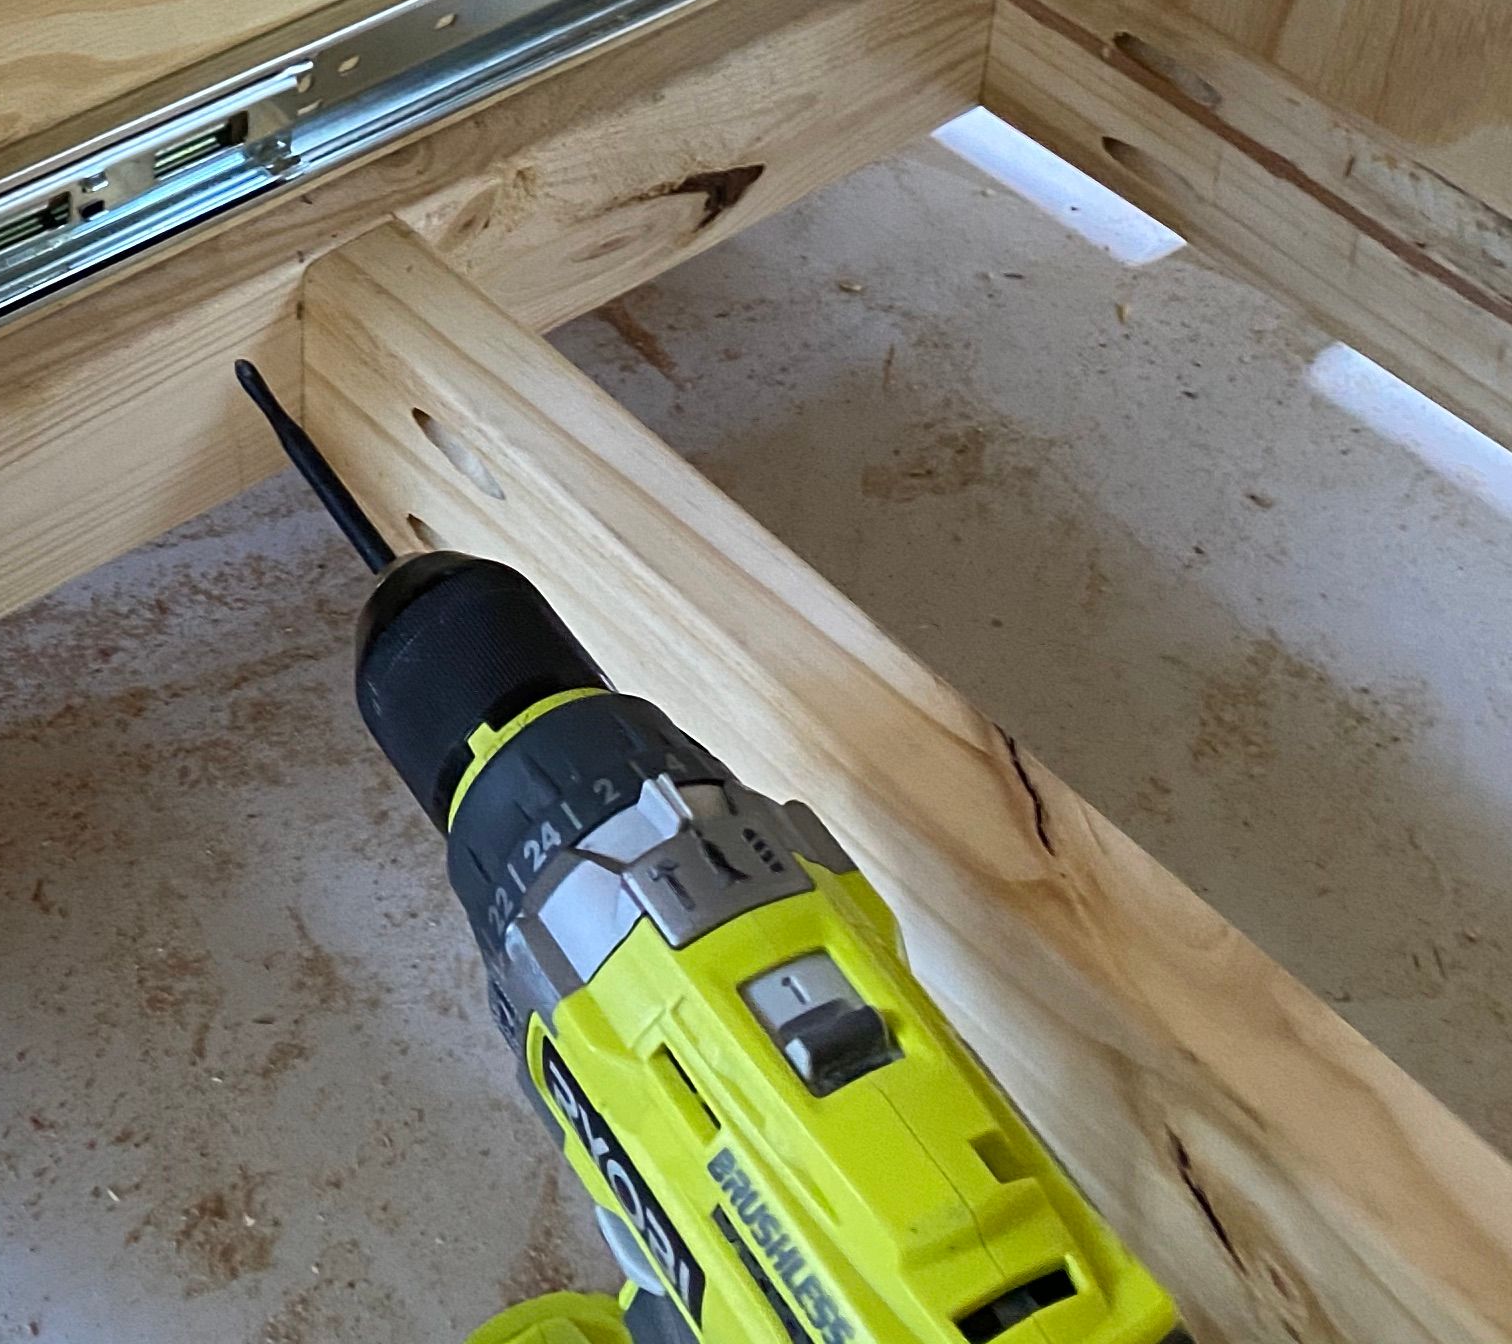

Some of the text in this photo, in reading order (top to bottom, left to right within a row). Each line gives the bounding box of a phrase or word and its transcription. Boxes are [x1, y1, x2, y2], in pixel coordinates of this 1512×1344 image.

[522, 820, 563, 873] 24
[592, 777, 622, 806] 2
[781, 976, 812, 1006] 1
[707, 1146, 856, 1344] BRUSHLESS
